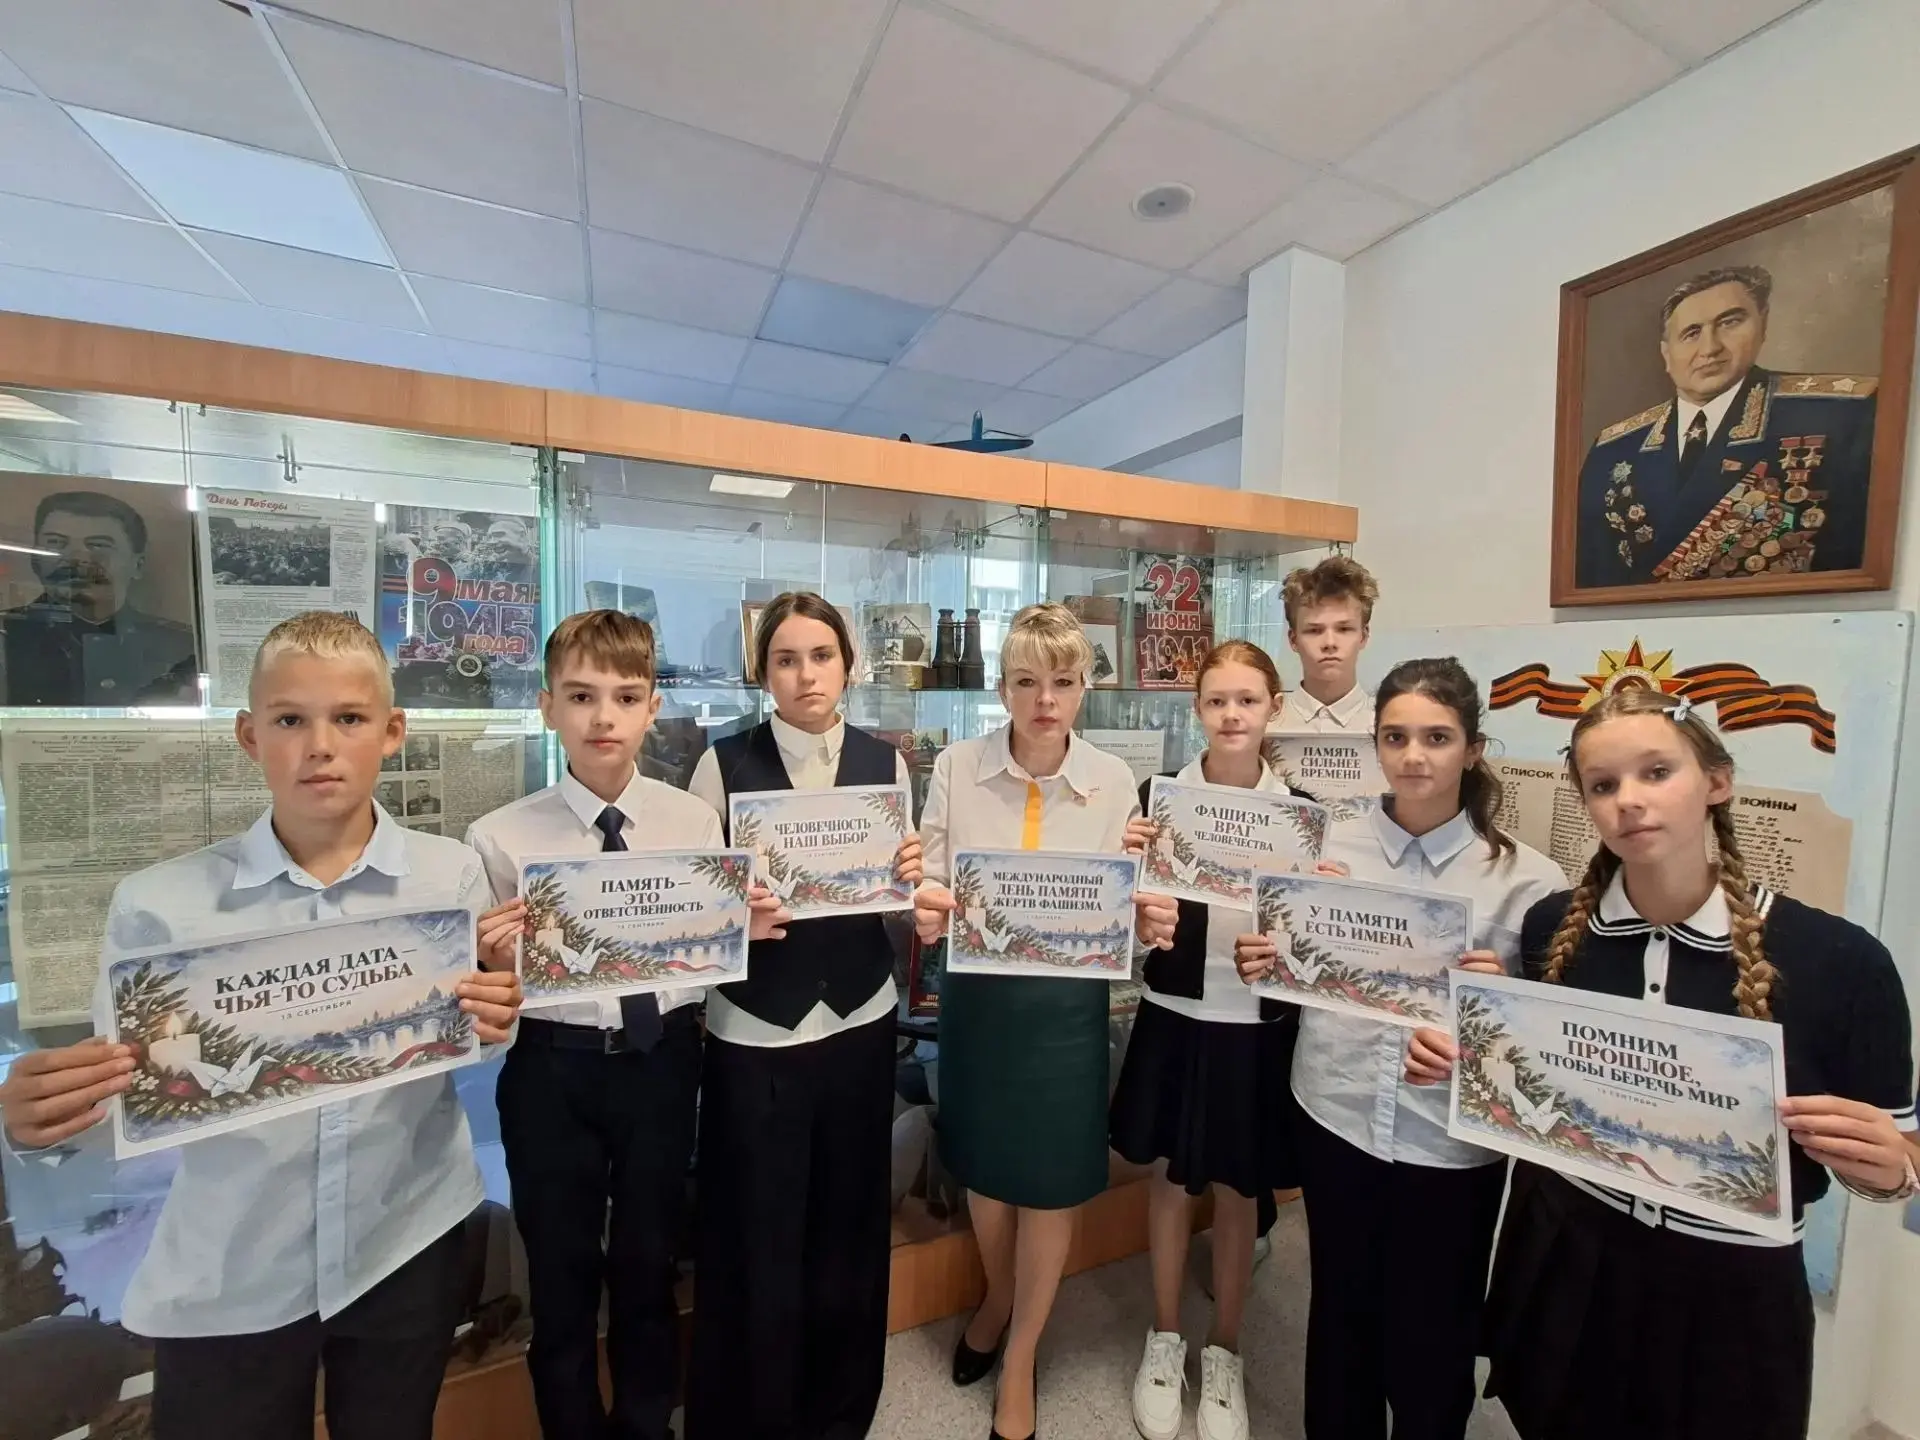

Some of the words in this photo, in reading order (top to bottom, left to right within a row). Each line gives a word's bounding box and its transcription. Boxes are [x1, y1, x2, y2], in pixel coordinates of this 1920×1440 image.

[207, 493, 240, 506] День
[244, 497, 288, 512] Победы
[406, 557, 458, 604] 9
[1148, 563, 1200, 613] 22
[1147, 612, 1200, 631] ИЮНЯ
[397, 599, 536, 666] 1945
[1140, 634, 1209, 682] 1941
[1303, 747, 1358, 757] ПАМЯТЬ
[1301, 757, 1360, 769] СИЛЬНЕЕ
[1301, 768, 1360, 780] ВРЕМЕНИ
[1501, 766, 1555, 780] СПИСОК
[1740, 797, 1797, 812] ВОЙНЫ
[1194, 804, 1270, 826] ФАШИЗМ
[775, 818, 871, 835] ЧЕЛОВЕЧНОСТЬ
[1214, 820, 1255, 837] ВРАГ
[783, 835, 817, 849] НАШ
[822, 831, 868, 846] ВЫБОР
[1194, 830, 1273, 852] ЧЕЛОВЕЧЕСТВА
[601, 877, 675, 893] ПАМЯТЬ
[993, 871, 1104, 886] МЕЖДУНАРОДНЫЙ
[624, 892, 660, 905] ЭТО
[996, 883, 1035, 896] ДЕНЬ
[1038, 885, 1098, 899] ПАМЯТИ
[583, 901, 704, 919] ОТВЕТСТВЕННОСТЬ
[993, 897, 1036, 908] ЖЕРТВ
[1039, 899, 1102, 911] ФАШИЗМА
[1309, 904, 1322, 918] У
[1329, 908, 1408, 931] ПАМЯТИ
[1305, 921, 1346, 937] ЕСТЬ
[1351, 927, 1414, 948] ИМЕНА
[216, 958, 331, 994] КАЖДАЯ
[338, 946, 398, 972] ДАТА
[213, 981, 315, 1015] ЧЬЯ-ТО
[322, 962, 414, 994] СУДЬБА
[297, 1002, 352, 1017] СЕНТЯБРЯ
[1562, 1021, 1678, 1060] ПОМНИМ
[1567, 1039, 1702, 1087] ПРОШЛОЕ,
[1539, 1051, 1604, 1078] ЧТОБЫ
[1611, 1068, 1684, 1097] БЕРЕЧЬ
[1688, 1085, 1740, 1111] МИР
